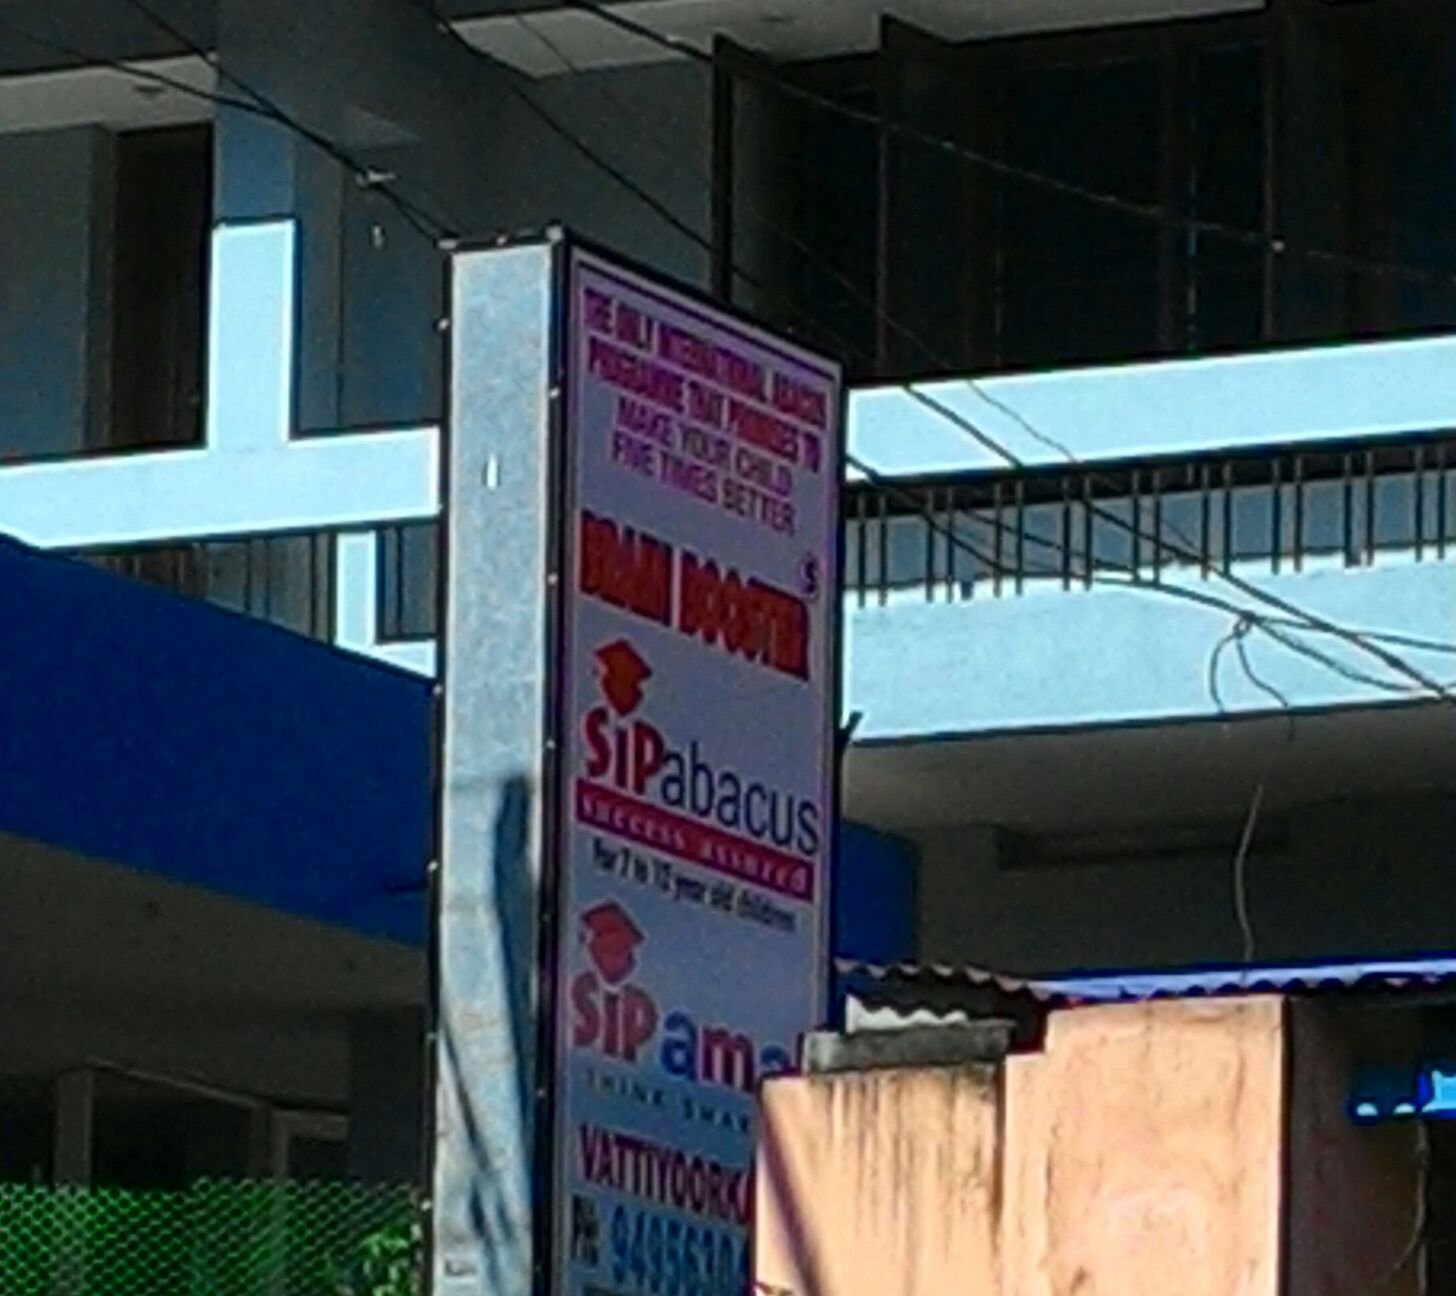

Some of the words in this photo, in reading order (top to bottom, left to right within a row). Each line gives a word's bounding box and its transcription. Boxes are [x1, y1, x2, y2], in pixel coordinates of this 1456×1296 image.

[617, 396, 675, 449] MAKE
[679, 421, 733, 471] YOUR
[736, 446, 792, 498] CHILD
[687, 379, 724, 425] THAT
[802, 430, 820, 473] TO
[612, 430, 655, 477] FIVE
[659, 450, 719, 503] TIMES
[722, 477, 796, 538] BETTER
[580, 507, 674, 627] BRAIN
[678, 548, 810, 682] BOOSTER
[634, 857, 649, 884] to
[586, 1067, 664, 1106] THINK
